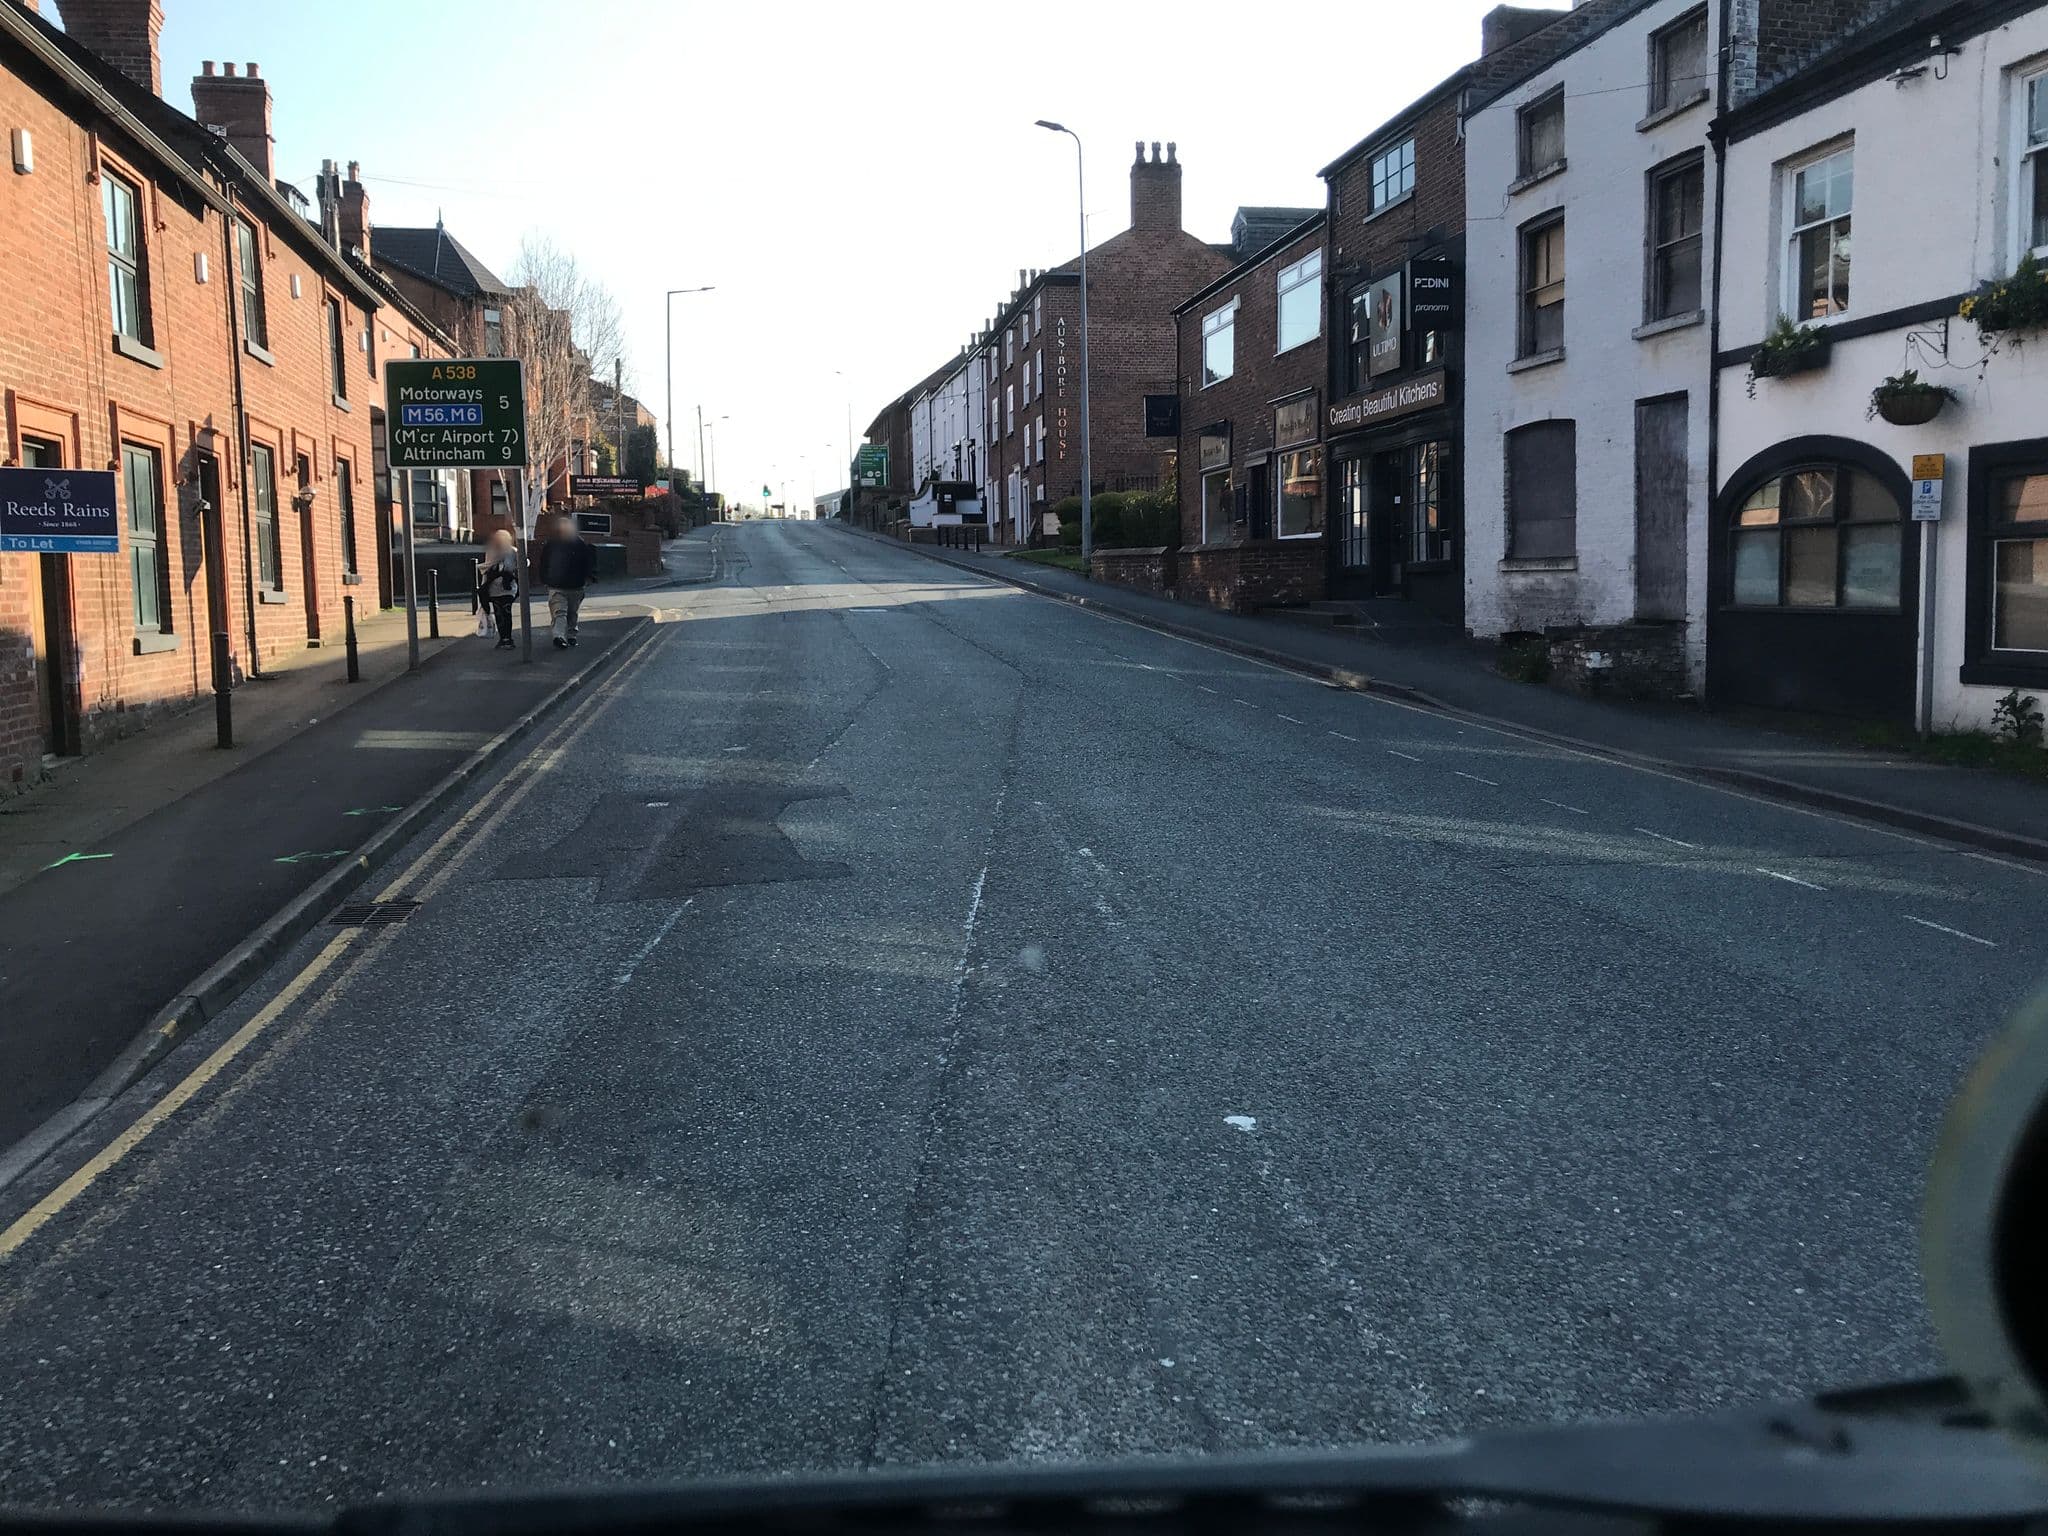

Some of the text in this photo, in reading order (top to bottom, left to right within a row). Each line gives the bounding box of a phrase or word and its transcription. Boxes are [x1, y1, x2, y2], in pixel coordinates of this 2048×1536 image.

[1414, 277, 1449, 288] PEDINI
[1415, 304, 1449, 313] pronorm
[1373, 336, 1397, 357] ULTIMO
[400, 387, 483, 402] Motorways
[499, 395, 510, 410] 5
[1329, 381, 1437, 425] Creating Beautiful Kitchens
[441, 430, 494, 445] Airport
[501, 428, 519, 444] 7)
[1058, 407, 1067, 459] HOUSE
[404, 446, 512, 461] Altrincham 9
[6, 501, 110, 518] Reeds Rains
[8, 537, 54, 549] To Let
